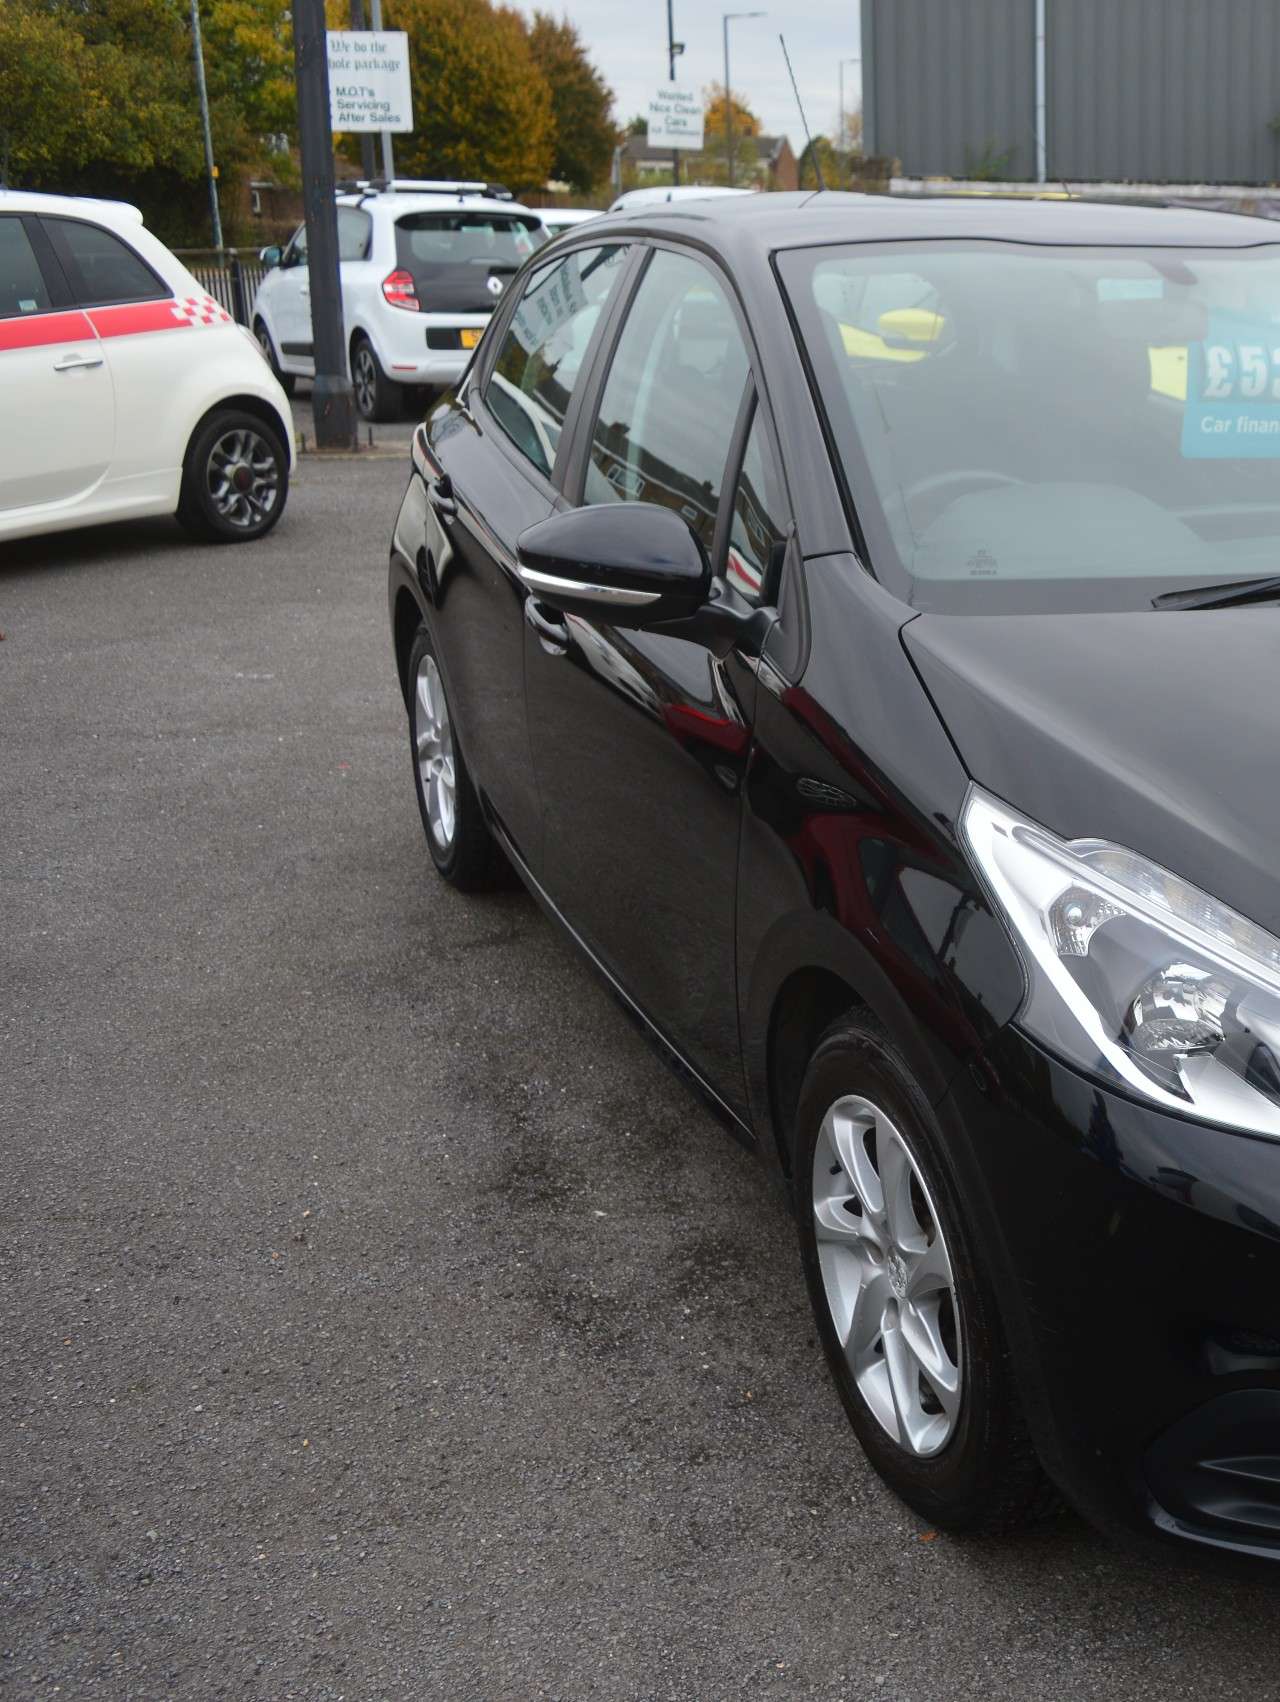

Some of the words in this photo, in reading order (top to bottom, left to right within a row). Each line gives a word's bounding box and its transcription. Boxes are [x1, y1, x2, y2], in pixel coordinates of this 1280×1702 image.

[337, 99, 390, 112] Servicing
[339, 112, 365, 122] After
[370, 112, 401, 122] Sales
[1200, 416, 1232, 433] Car
